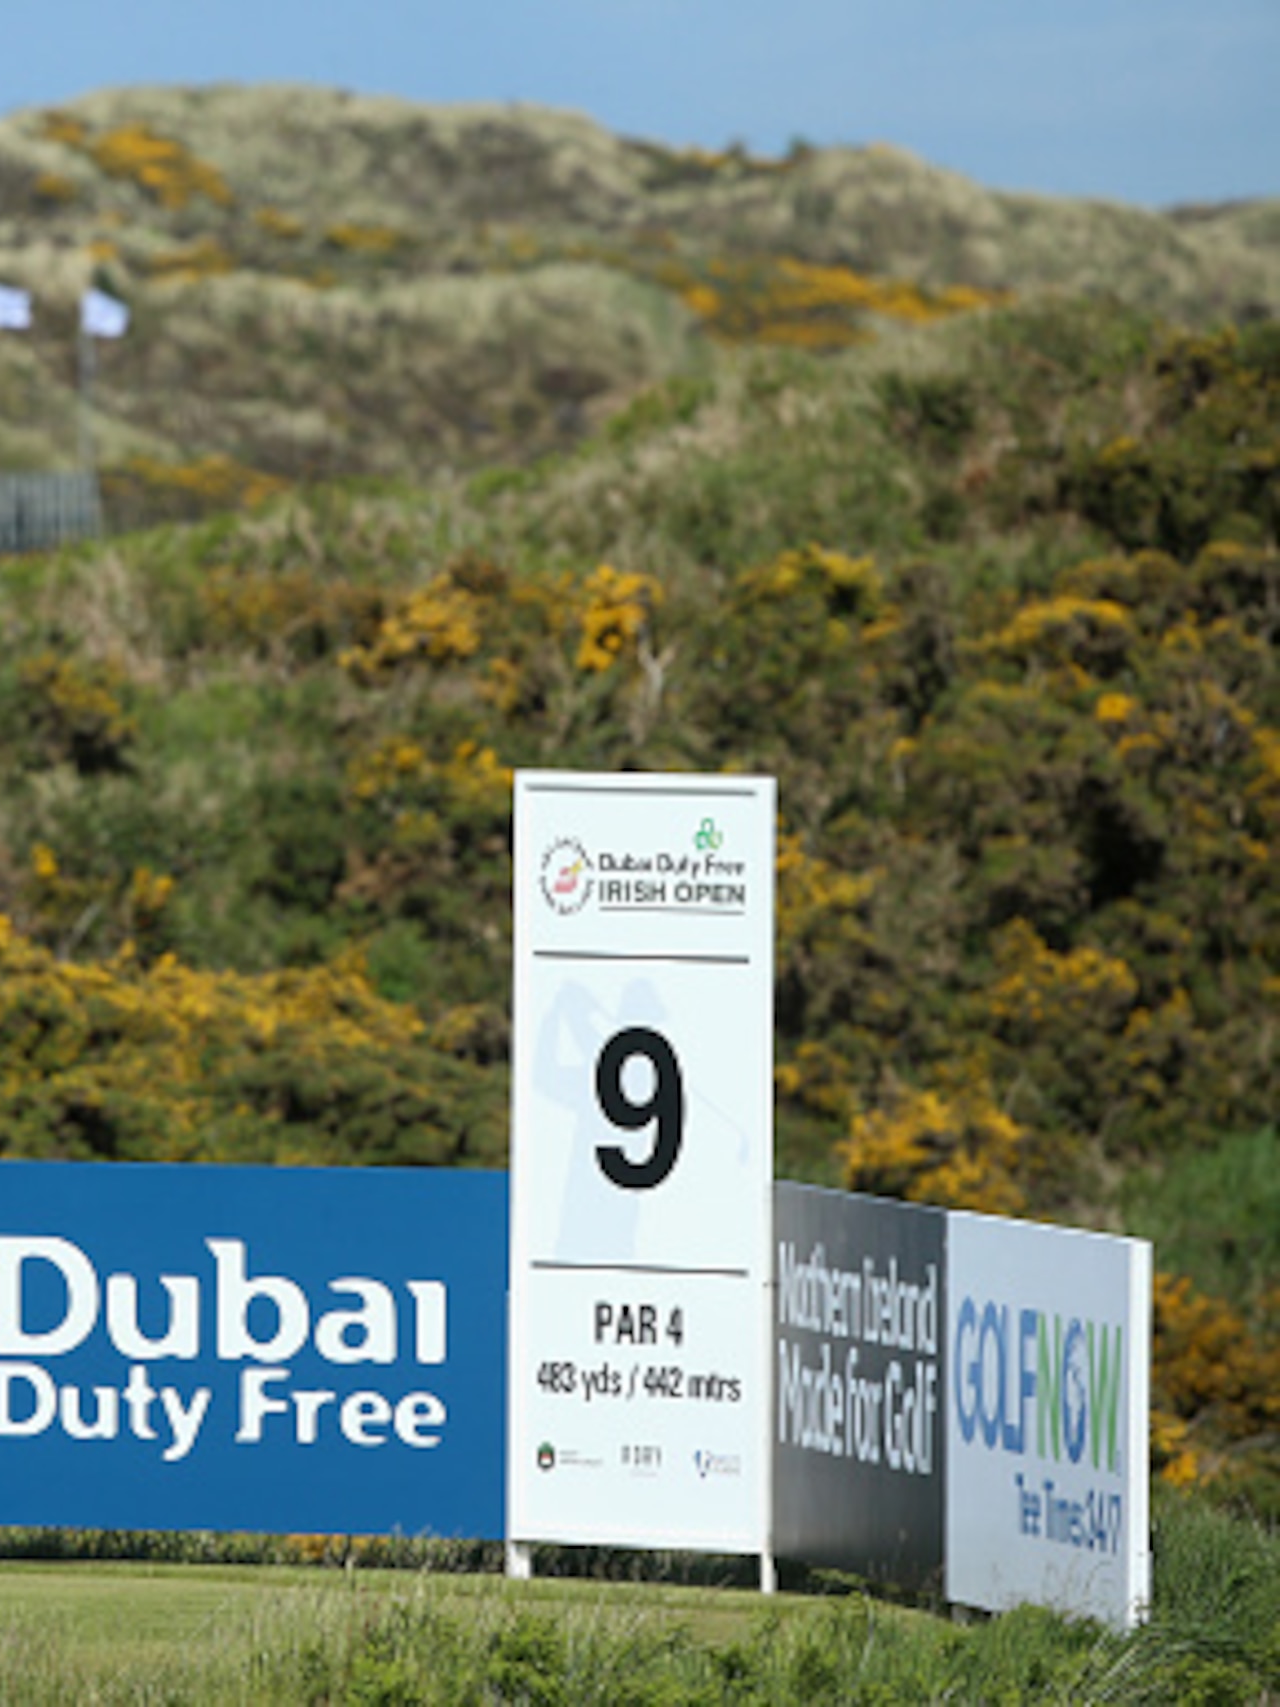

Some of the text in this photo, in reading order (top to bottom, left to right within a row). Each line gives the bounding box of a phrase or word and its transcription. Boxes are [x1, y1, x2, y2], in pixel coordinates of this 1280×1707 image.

[598, 853, 746, 879] Dubai Duty Free
[598, 880, 747, 904] IRISH OPEN
[595, 1026, 686, 1191] 9
[594, 1300, 685, 1348] PAR 4
[778, 1240, 938, 1355] Northern Ireland
[235, 1367, 447, 1448] Free
[536, 1361, 578, 1394] 483
[581, 1362, 622, 1402] yds
[642, 1366, 684, 1399] 442
[687, 1374, 742, 1403] mtrs
[778, 1338, 937, 1475] Made for Golf
[953, 1295, 1122, 1473] GOLFNOW
